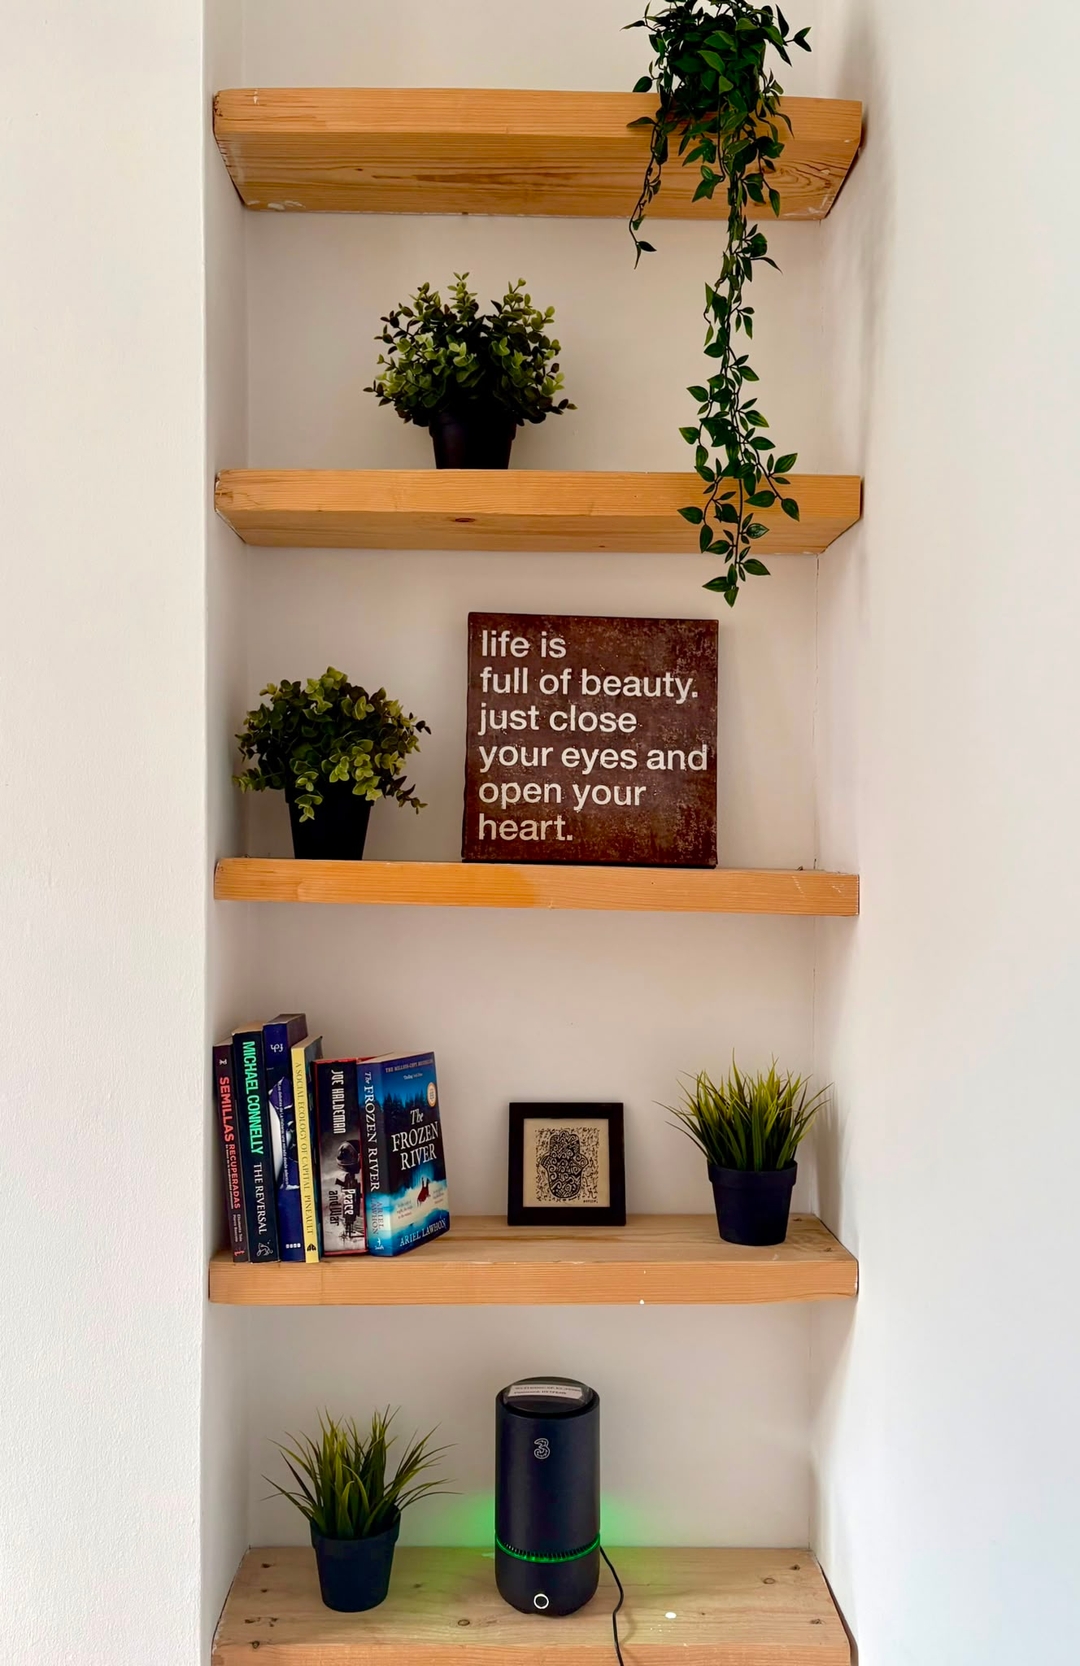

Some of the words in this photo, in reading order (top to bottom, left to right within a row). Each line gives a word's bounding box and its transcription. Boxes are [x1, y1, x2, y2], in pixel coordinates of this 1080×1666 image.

[481, 630, 529, 657] life
[540, 631, 566, 658] is
[479, 666, 528, 694] full
[539, 668, 572, 695] of
[581, 668, 698, 704] beauty.
[478, 702, 540, 735] just
[549, 704, 637, 733] close
[478, 745, 553, 773] your
[561, 746, 638, 775] eyes
[646, 744, 707, 770] and
[478, 782, 561, 810] open
[573, 783, 646, 811] your
[478, 813, 573, 841] heart.
[243, 1041, 259, 1095] MICHAEL
[296, 1069, 304, 1098] SOCIAL
[331, 1070, 344, 1086] JOE
[364, 1072, 372, 1084] The
[219, 1076, 235, 1142] SEMILLAS
[247, 1095, 264, 1154] CONNELLY
[298, 1101, 307, 1140] ECOLOGY
[332, 1088, 346, 1134] HALDEMAN
[364, 1085, 377, 1143] FROZEN
[410, 1108, 424, 1125] The
[300, 1143, 308, 1153] OF
[391, 1121, 438, 1152] FROZEN
[368, 1148, 380, 1192] RIVER
[400, 1143, 437, 1170] RIVER
[228, 1143, 241, 1209] RECUPERADAS
[253, 1162, 264, 1184] THE
[301, 1156, 311, 1189] CAPITAL
[255, 1185, 267, 1235] REVERSAL
[328, 1190, 341, 1207] and
[342, 1186, 356, 1215] Peace
[304, 1194, 314, 1235] PINEAULT
[329, 1207, 342, 1226] War
[371, 1197, 379, 1235] LAWHON
[377, 1201, 385, 1228] ARIEL
[399, 1230, 421, 1246] ARIEL
[421, 1217, 447, 1238] LAWHON
